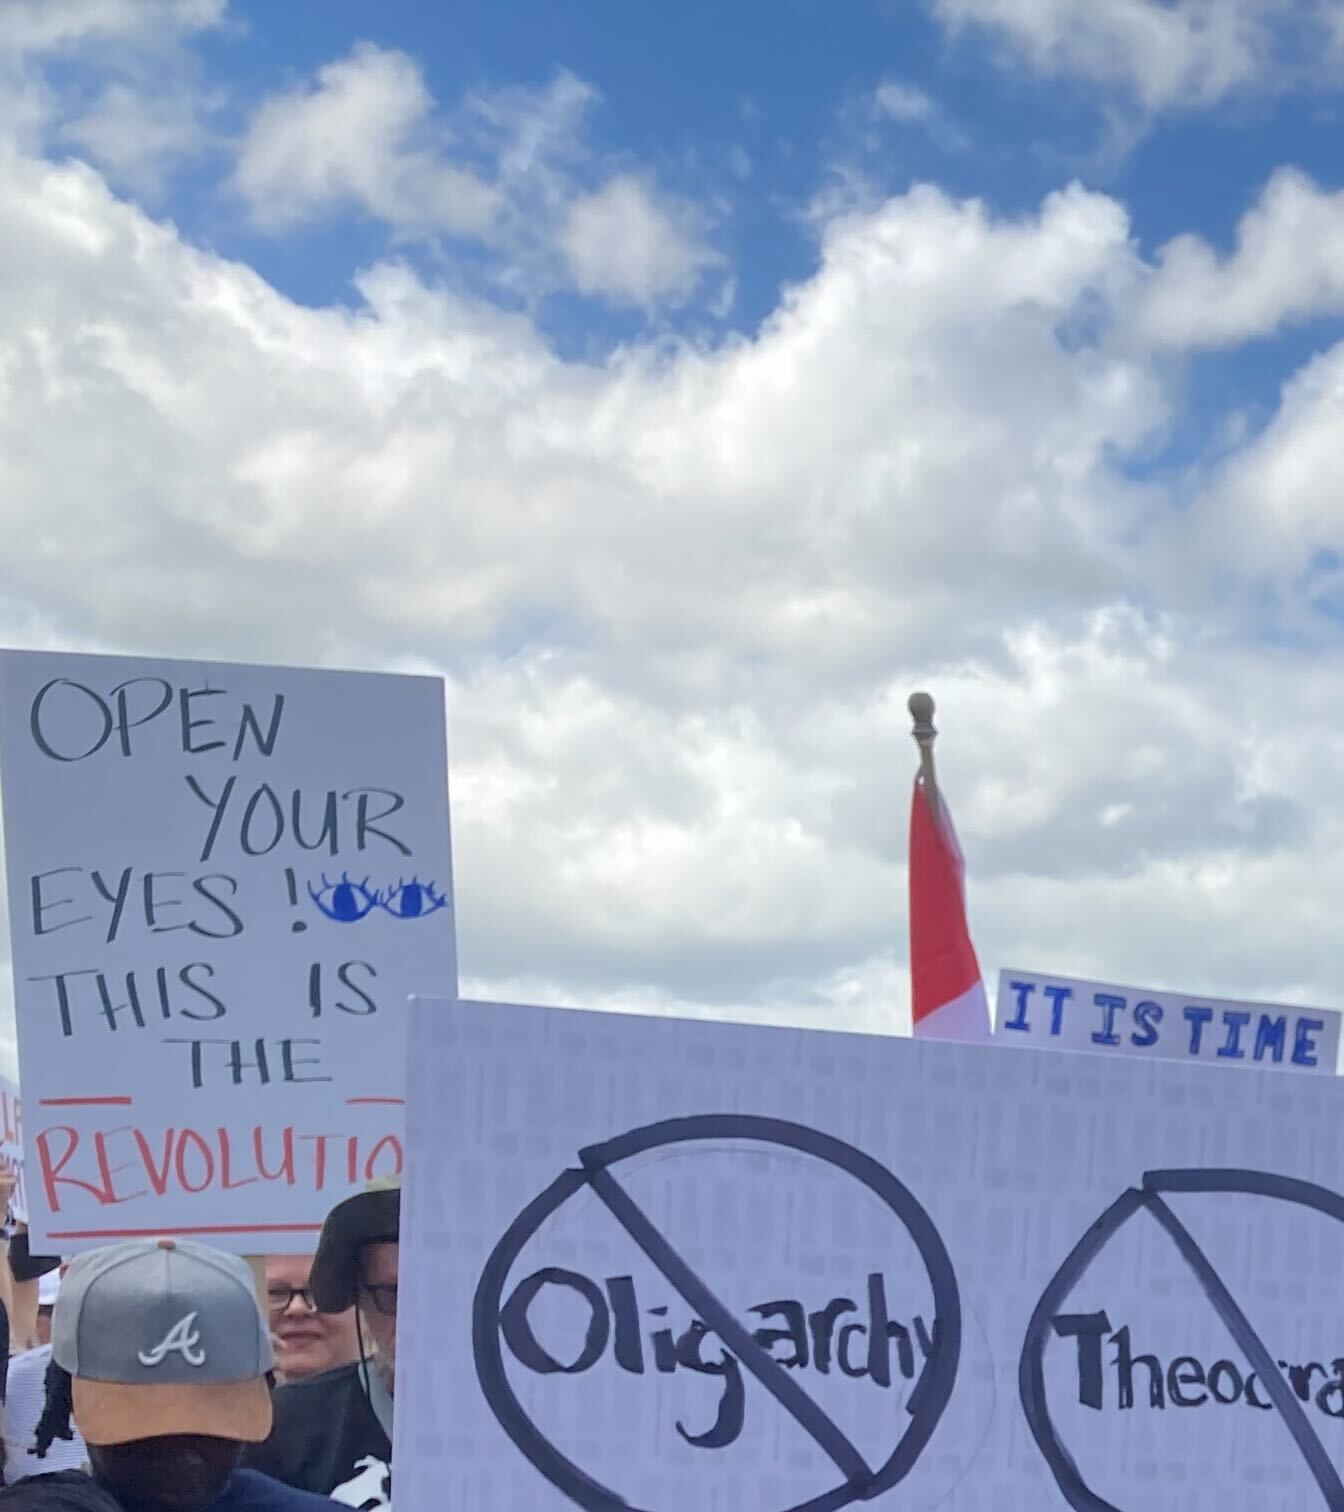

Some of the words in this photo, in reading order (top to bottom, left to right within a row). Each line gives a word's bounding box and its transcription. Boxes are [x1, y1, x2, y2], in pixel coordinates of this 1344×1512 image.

[30, 677, 285, 762] OPEN
[185, 775, 413, 862] YOUR
[26, 962, 227, 1037] THIS
[309, 960, 379, 1019] IS
[1005, 981, 1073, 1036] IT
[1091, 992, 1164, 1047] IS
[1183, 1006, 1324, 1067] TIME
[162, 1038, 333, 1089] THE
[36, 1125, 403, 1212] REVOLUTIO
[499, 1267, 942, 1449] Oligarchy
